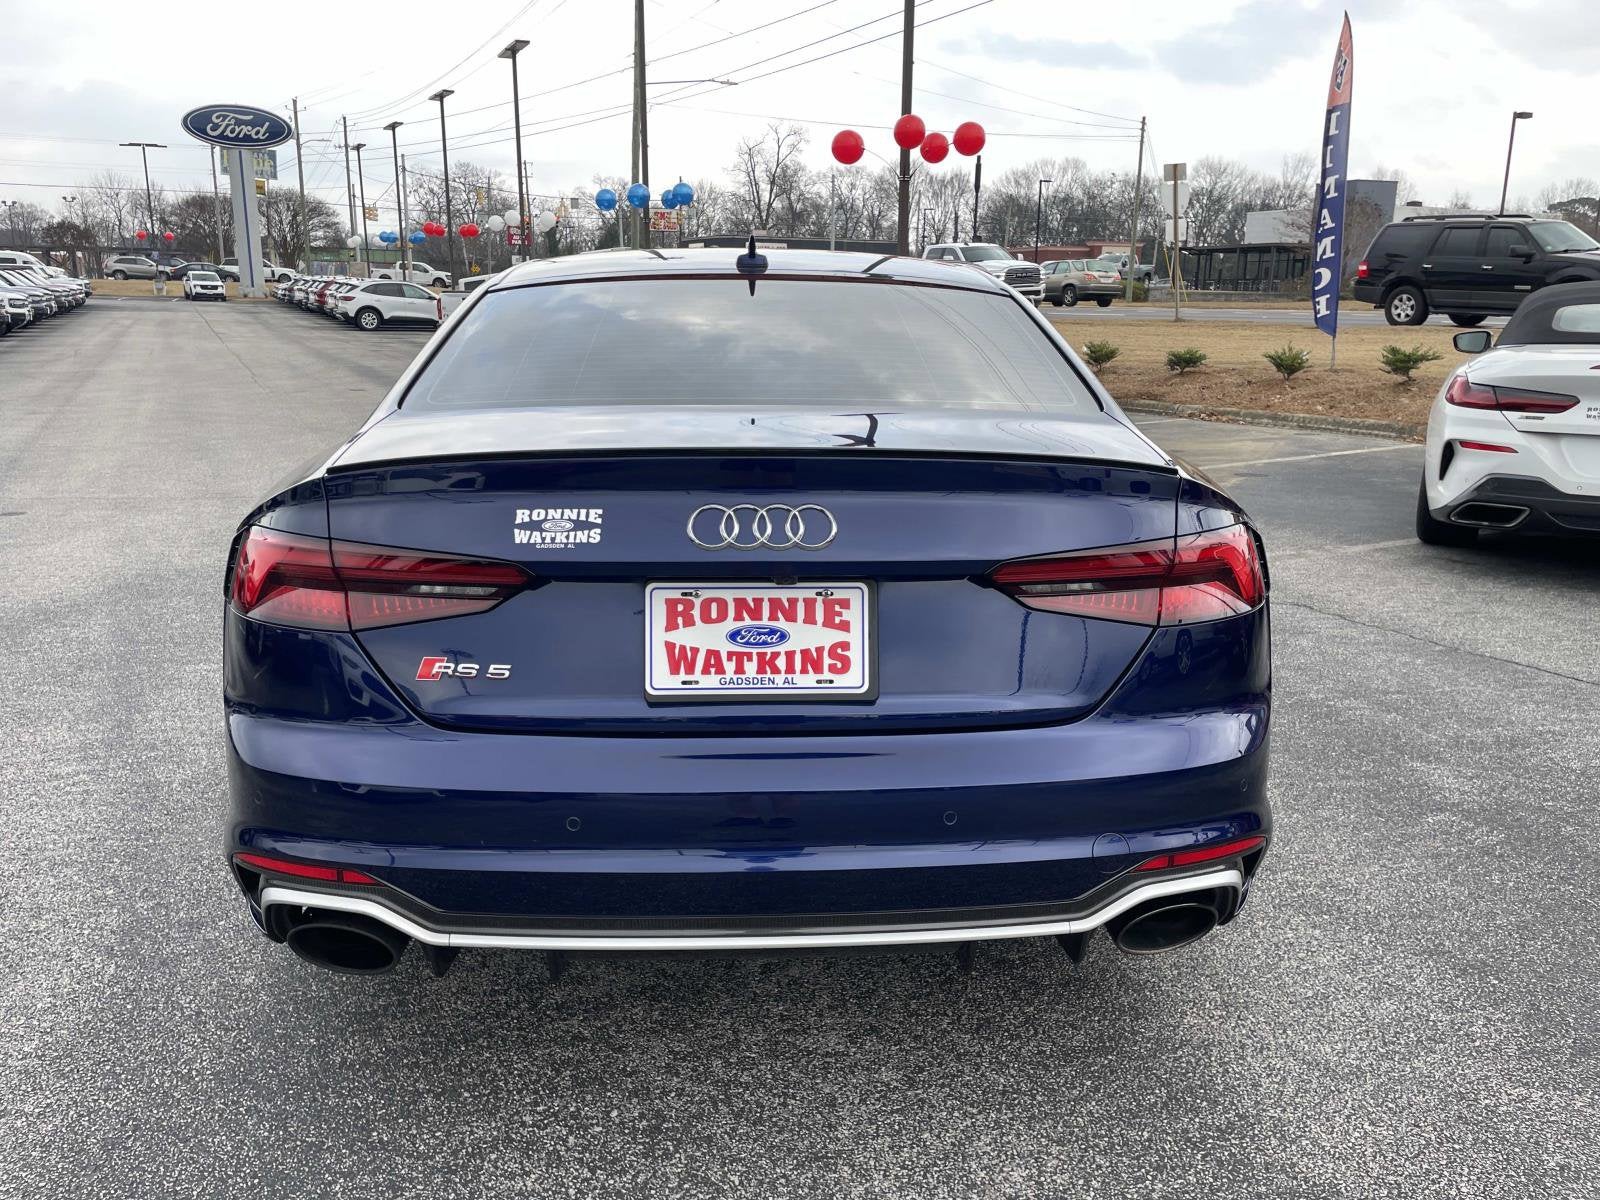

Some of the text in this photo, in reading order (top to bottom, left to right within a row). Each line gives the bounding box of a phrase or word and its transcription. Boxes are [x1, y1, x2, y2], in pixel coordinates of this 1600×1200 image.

[206, 111, 270, 139] Ford
[515, 508, 603, 524] RONNIE
[548, 522, 568, 530] Ford
[513, 528, 602, 544] WATKINS
[664, 596, 851, 634] RONNIE
[736, 627, 781, 644] Ford
[664, 640, 852, 676] WATKINS
[431, 662, 512, 679] RS 5
[719, 676, 798, 687] GADSDEN, AL
